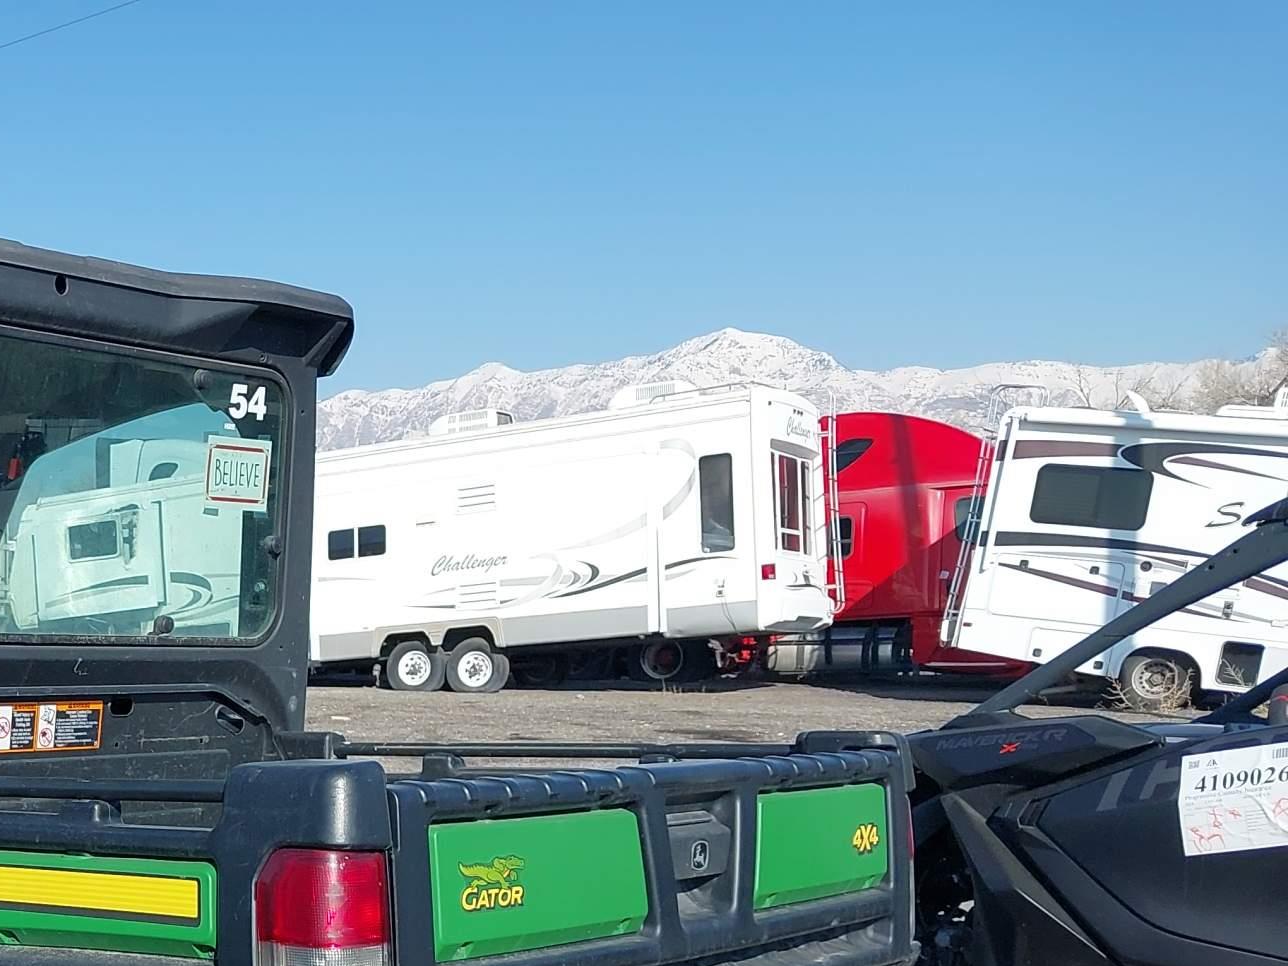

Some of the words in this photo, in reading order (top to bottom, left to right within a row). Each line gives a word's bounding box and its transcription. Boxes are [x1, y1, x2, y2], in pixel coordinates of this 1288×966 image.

[228, 383, 267, 421] 54
[214, 458, 260, 488] BELIEVE
[431, 553, 508, 577] Challenger
[852, 823, 879, 852] 4X4
[461, 884, 524, 912] GATOR
